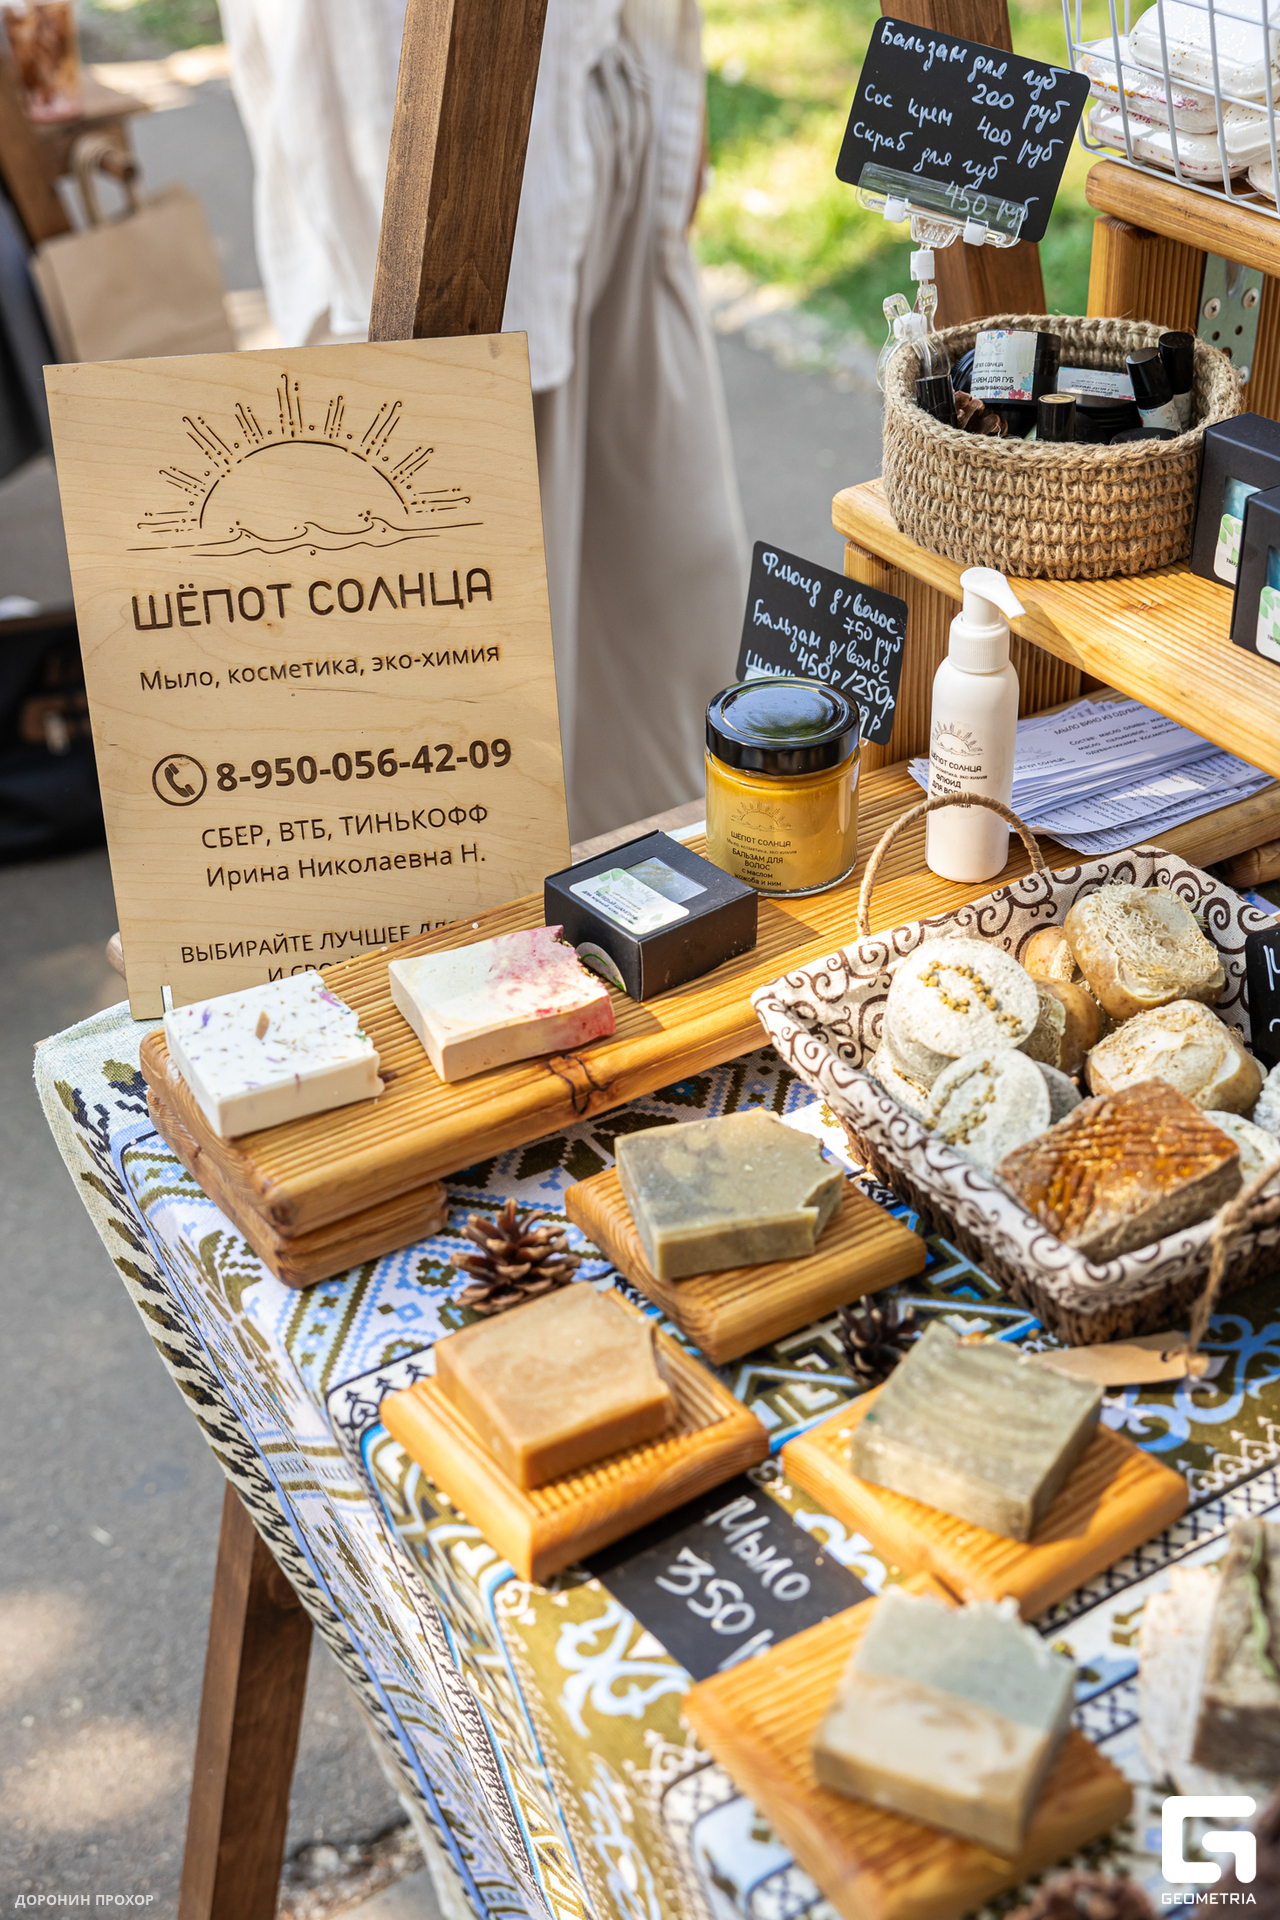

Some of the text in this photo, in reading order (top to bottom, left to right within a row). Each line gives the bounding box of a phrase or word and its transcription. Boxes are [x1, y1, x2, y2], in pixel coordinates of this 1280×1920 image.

[880, 21, 1070, 100] Бальзам для губ
[972, 84, 1070, 133] 200 руб
[853, 122, 1008, 190] Скраб для губ
[908, 98, 953, 128] крем
[977, 115, 1012, 146] 400
[1017, 139, 1064, 169] руб
[945, 181, 1040, 229] 450 руб
[131, 566, 493, 631] ШЁПОТ СОЛНЦА
[763, 551, 822, 608] Флюид
[753, 598, 821, 653] Бальзам
[843, 617, 904, 666] 750 руб
[140, 645, 500, 692] Мыло, косметика, эко-химия
[1054, 724, 1080, 735] МЫЛО
[1080, 717, 1102, 727] ВИНО
[216, 738, 512, 791] 8-950-056-42-09
[936, 774, 961, 789] ФЛЮИД
[949, 762, 981, 772] СОЛНЦА
[201, 803, 488, 850] СБЕР, ВТБ, ТИНЬКОФФ
[758, 839, 791, 847] СОЛНЦА
[206, 842, 486, 889] Ирина Николаевна Н.
[732, 848, 765, 862] БАЛЬЗАМ
[734, 873, 759, 884] жожоба
[744, 860, 770, 870] ВОЛОС
[747, 870, 773, 878] маслом
[181, 933, 314, 963] ВЫБИРАЙТЕ
[320, 925, 410, 950] ЛУЧШЕЕ
[703, 1496, 811, 1601] Мыло
[655, 1546, 756, 1635] 350
